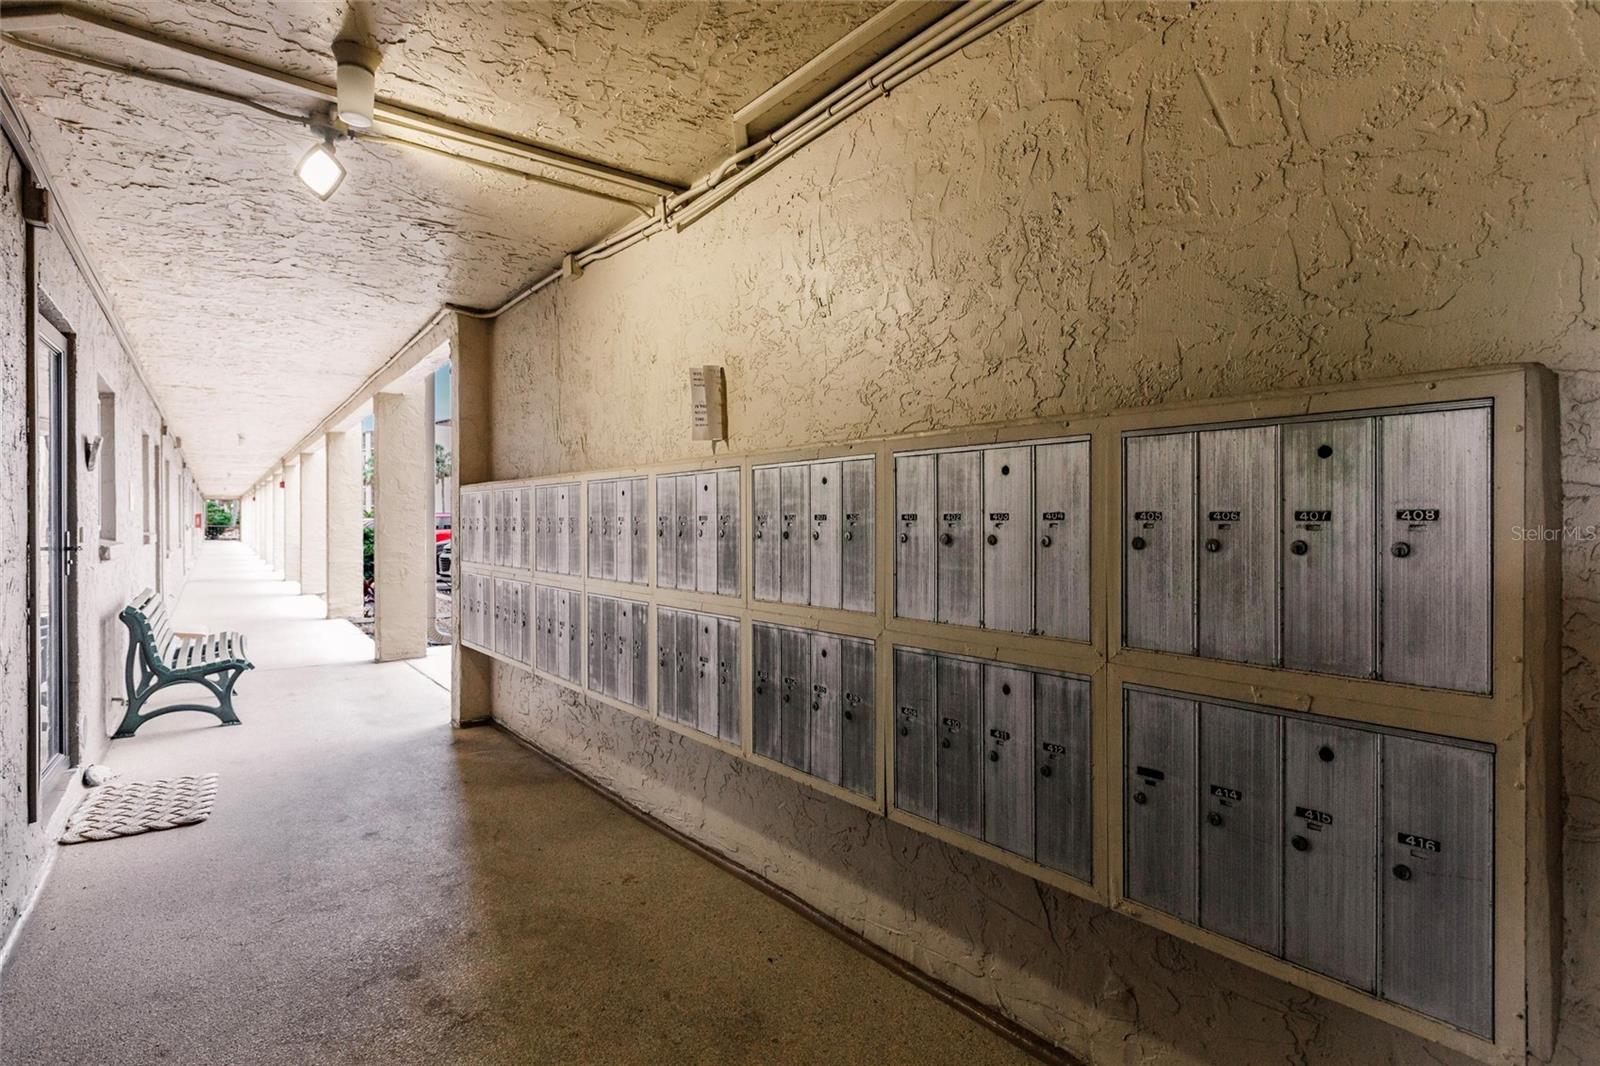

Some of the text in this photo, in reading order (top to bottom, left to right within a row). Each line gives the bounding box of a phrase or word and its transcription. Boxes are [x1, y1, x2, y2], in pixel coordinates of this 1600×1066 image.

[946, 513, 961, 521] 402
[992, 513, 1009, 521] 403
[1140, 511, 1162, 520] 405
[1213, 511, 1239, 520] 406
[1299, 511, 1328, 521] 407
[1400, 510, 1436, 521] 408
[1047, 744, 1064, 754] 412
[1215, 788, 1238, 800] 414
[1304, 809, 1331, 824] 415
[1405, 835, 1436, 851] 416
